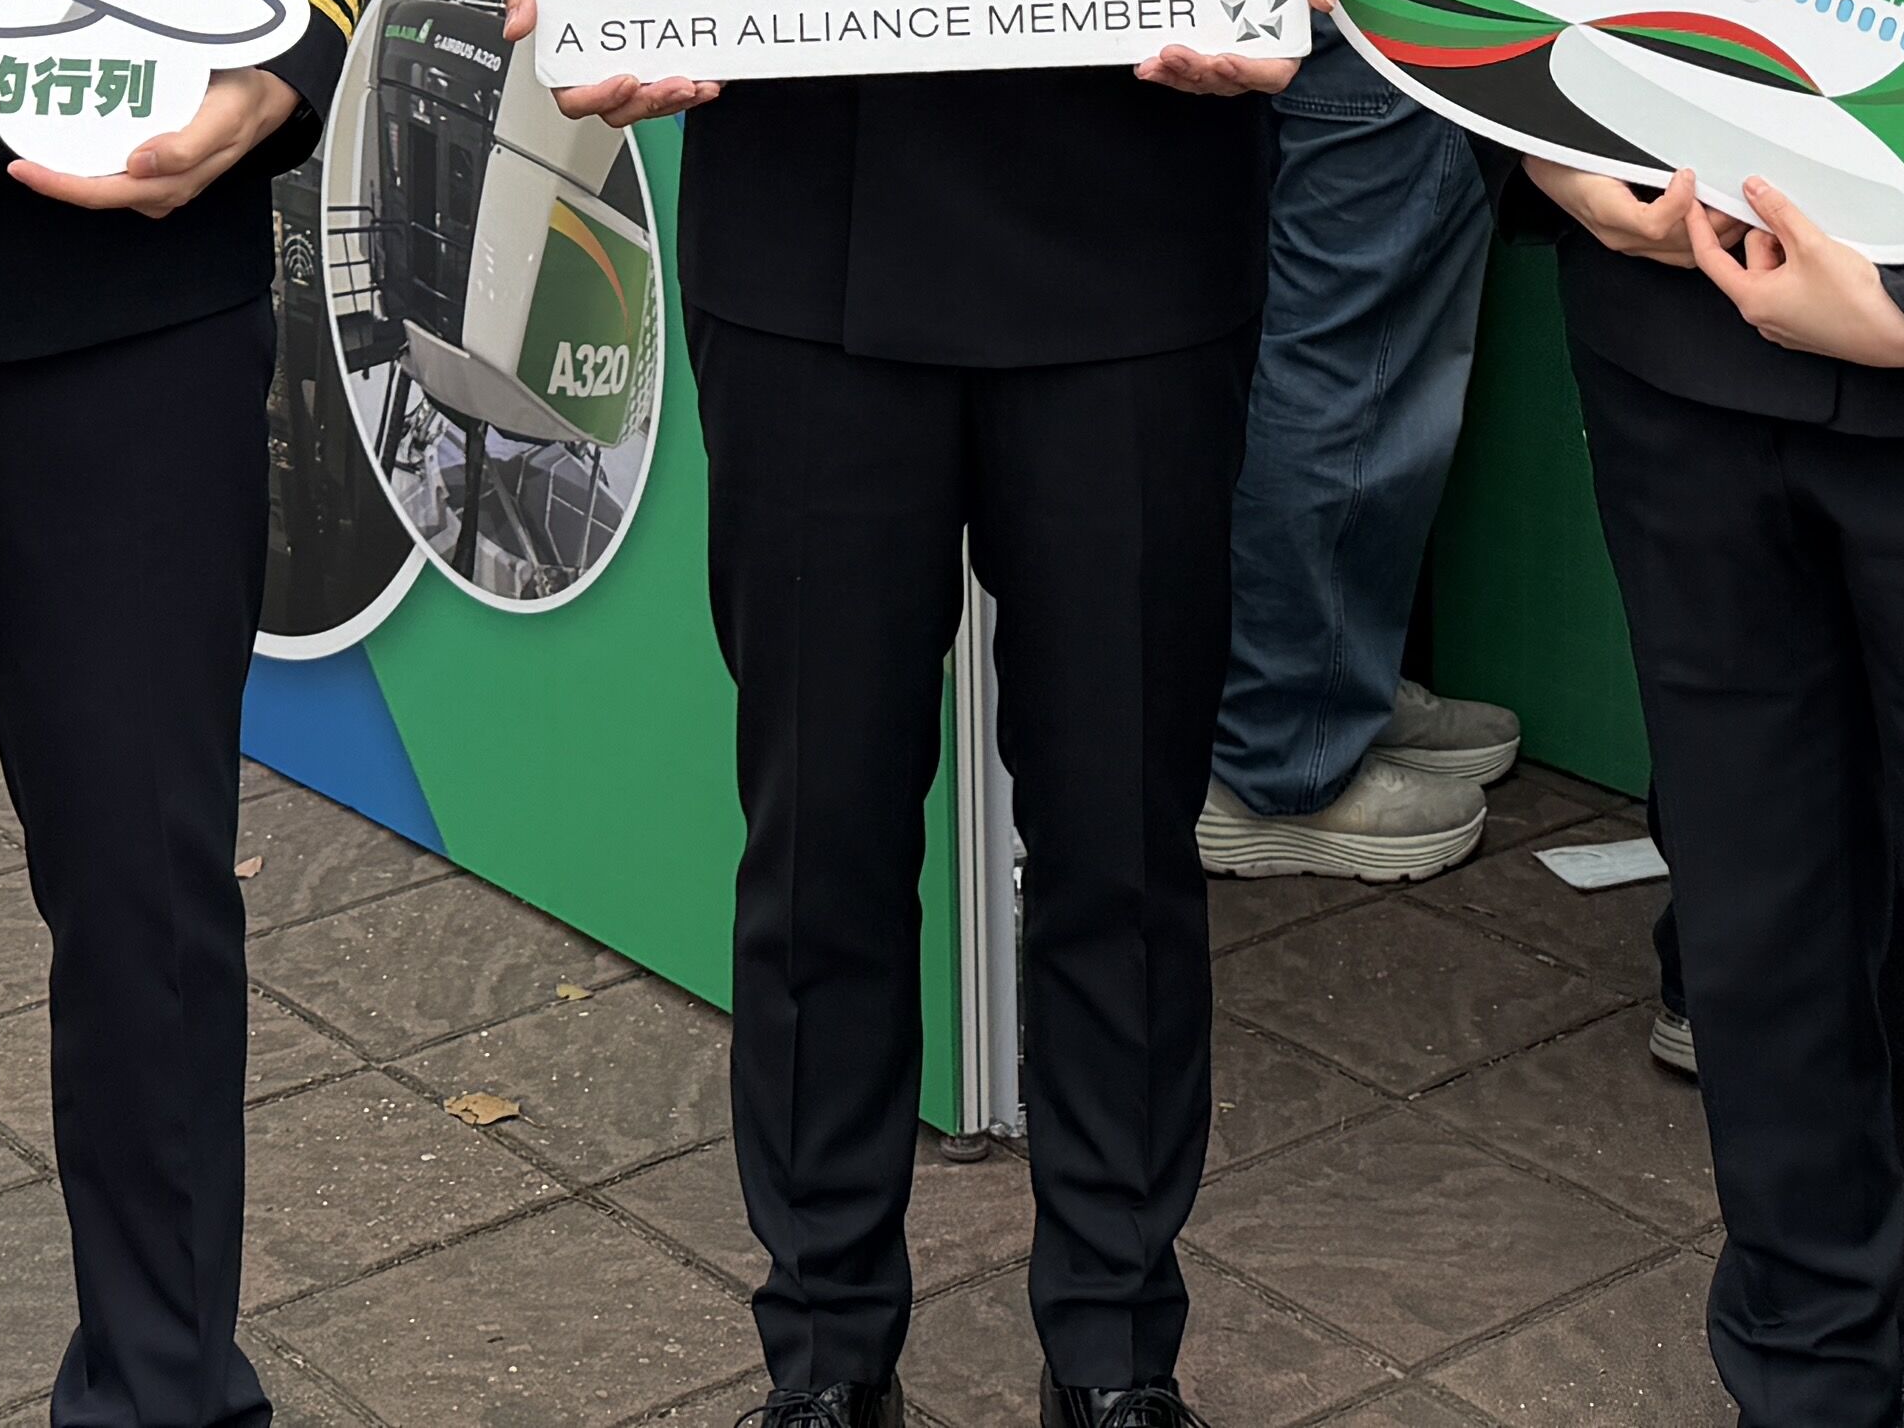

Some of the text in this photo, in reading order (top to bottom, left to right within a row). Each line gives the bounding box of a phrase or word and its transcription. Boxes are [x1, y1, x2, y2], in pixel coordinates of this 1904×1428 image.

[555, 23, 583, 54] A
[600, 14, 718, 53] STAR
[736, 5, 972, 48] ALLIANCE
[547, 340, 631, 398] A320
